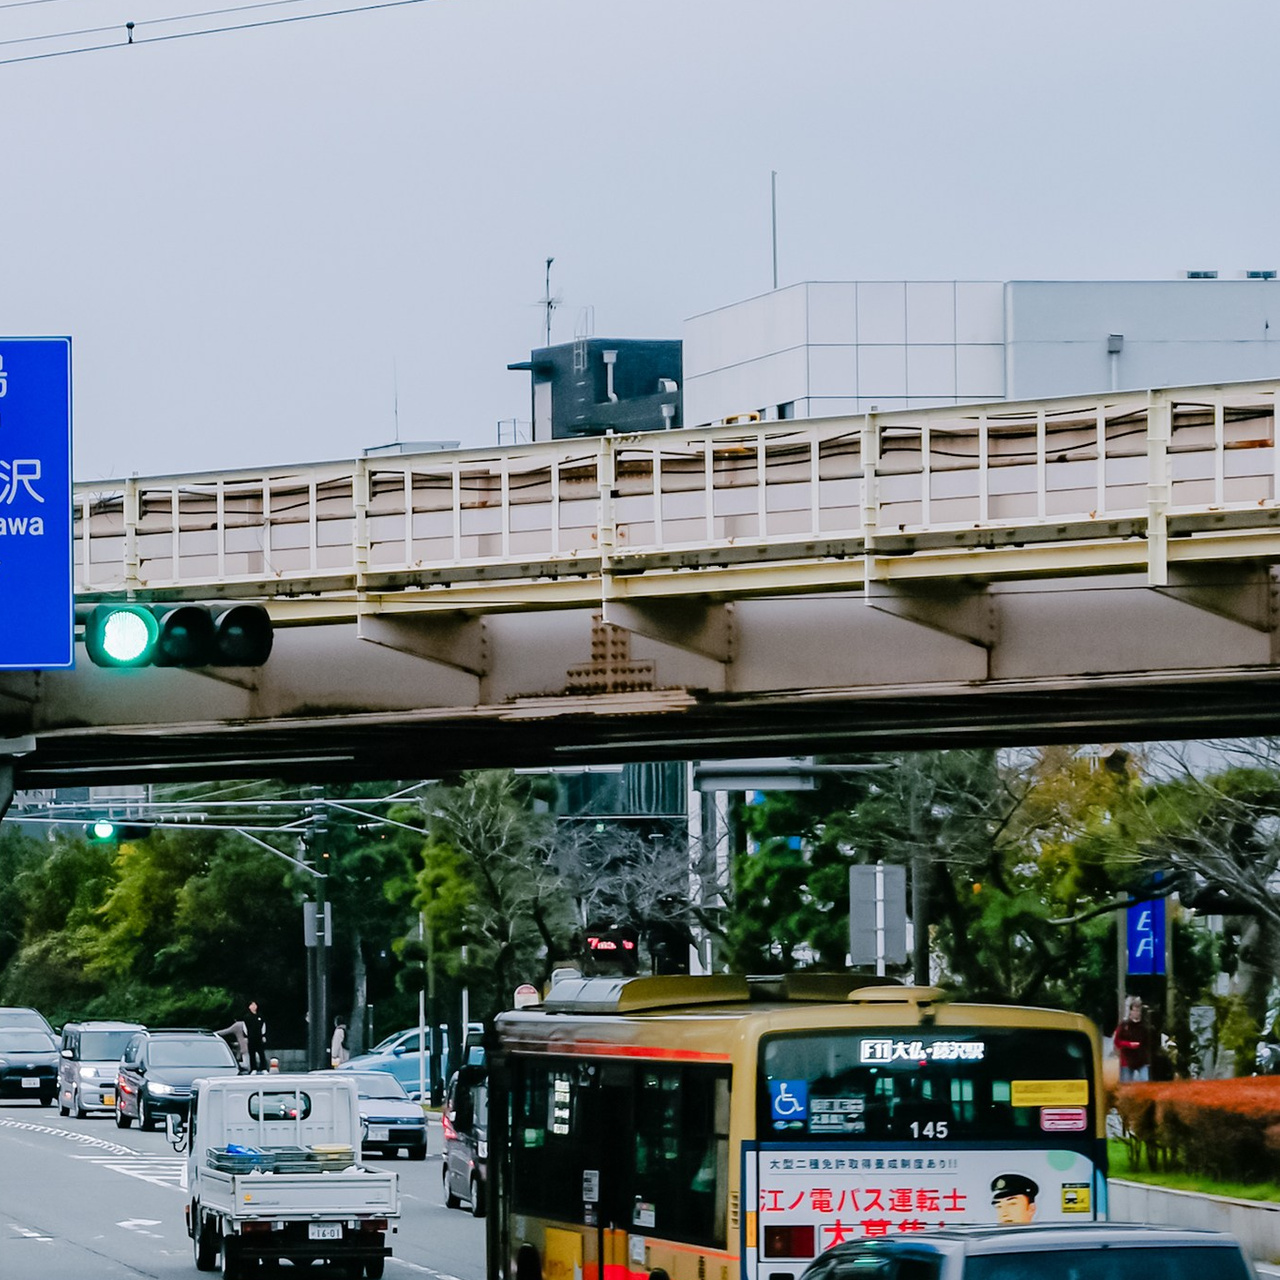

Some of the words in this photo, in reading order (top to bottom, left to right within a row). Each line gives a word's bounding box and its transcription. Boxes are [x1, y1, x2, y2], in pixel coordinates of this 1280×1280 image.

[910, 1121, 948, 1139] 145
[760, 1188, 967, 1213] 江ノ電バス運転士
